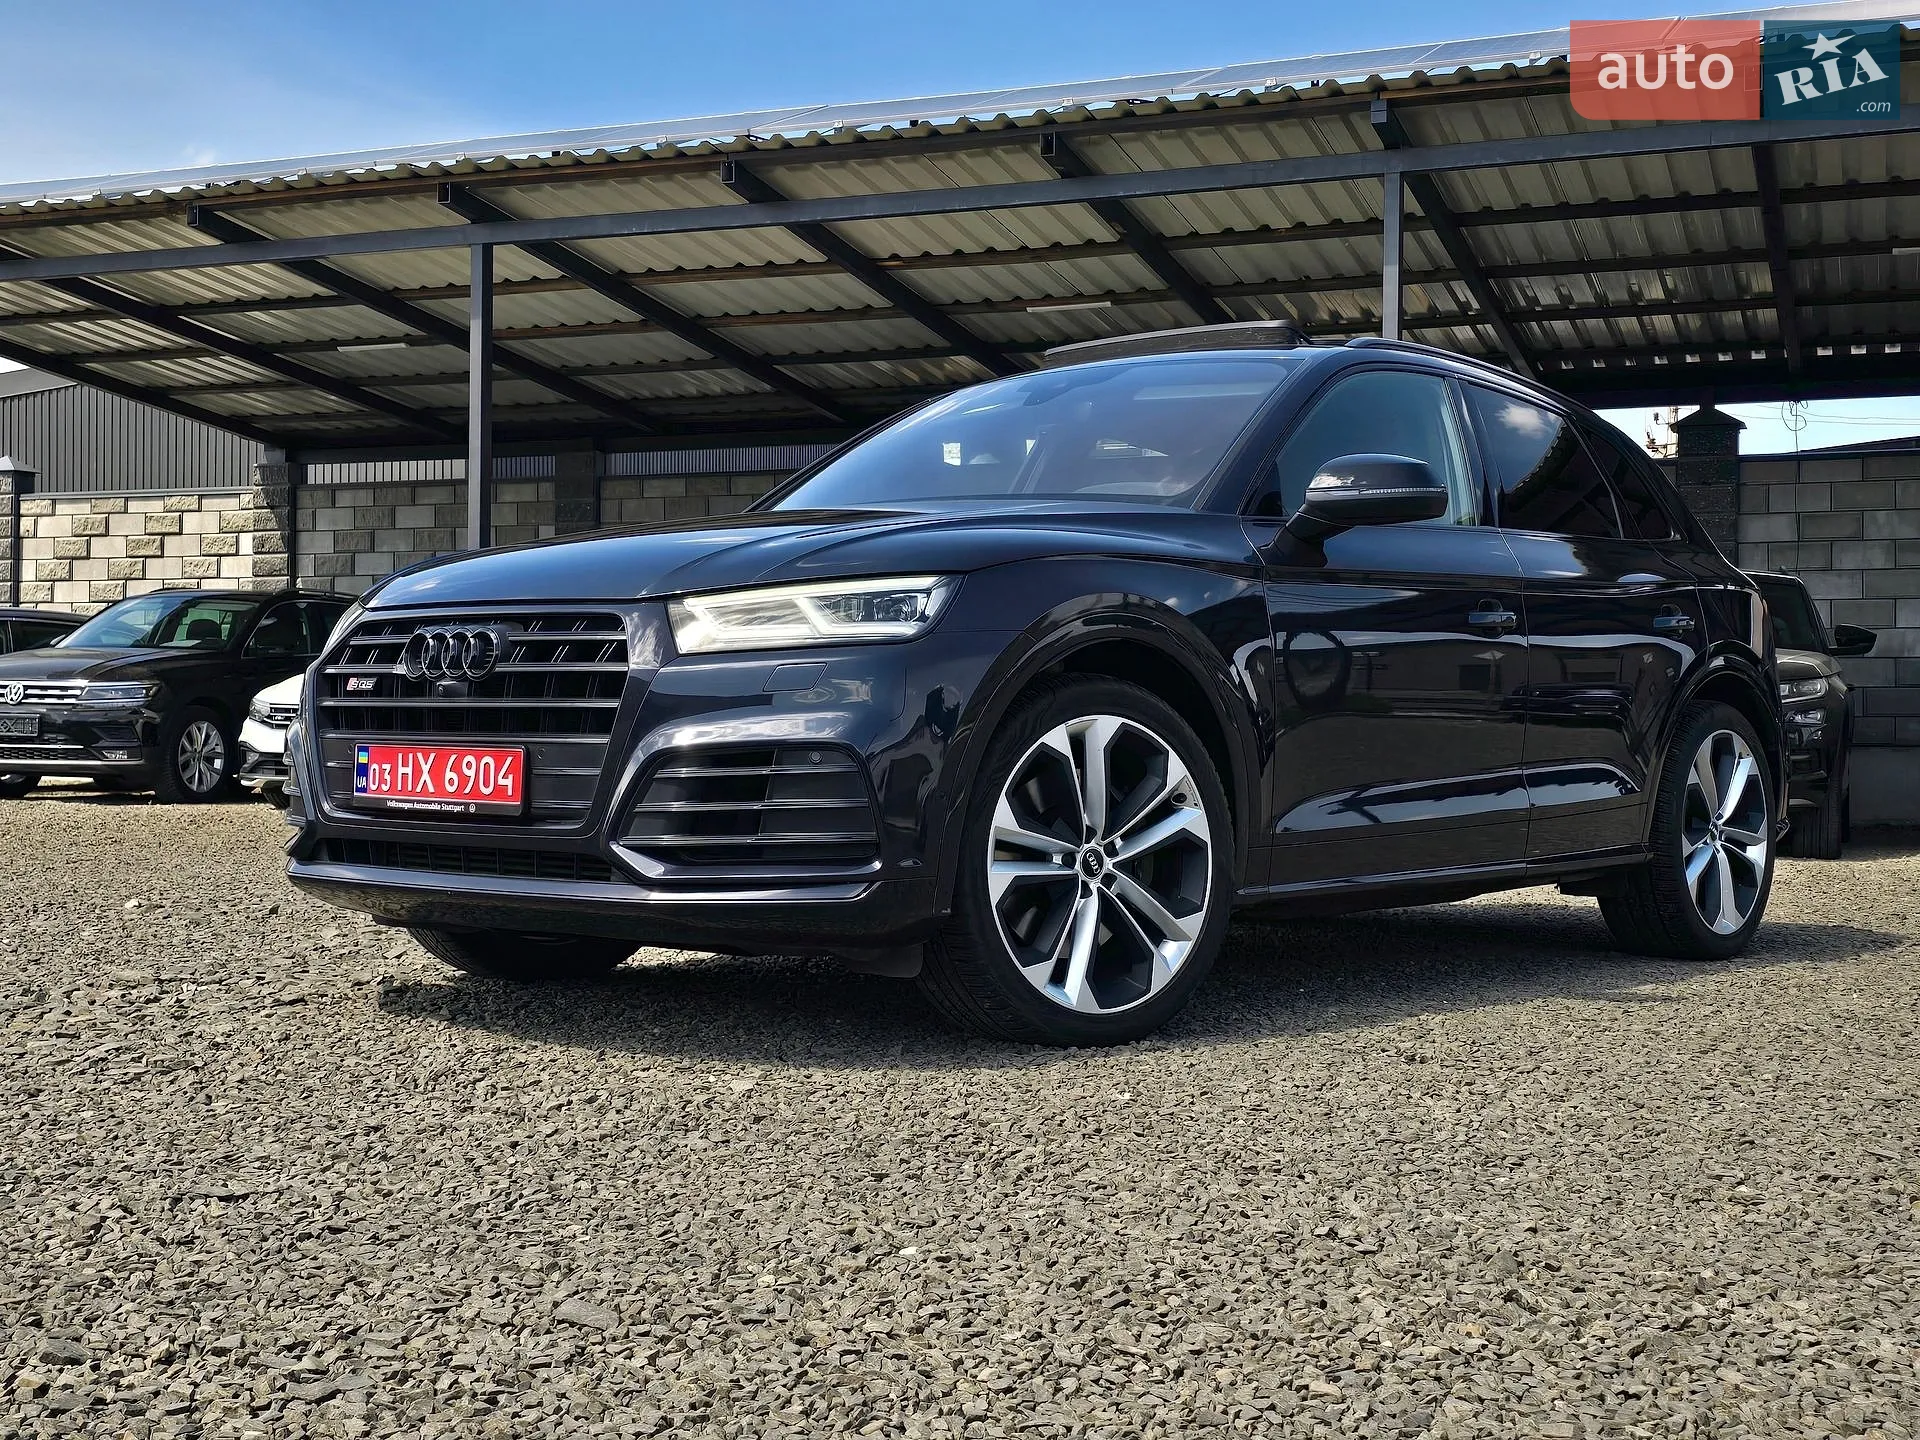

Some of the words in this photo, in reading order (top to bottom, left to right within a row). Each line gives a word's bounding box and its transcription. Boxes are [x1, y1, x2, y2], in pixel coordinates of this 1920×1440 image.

[369, 763, 392, 792] 03
[397, 752, 436, 793] HX
[444, 754, 514, 797] 6904
[357, 776, 367, 788] UA
[386, 800, 414, 810] Volkswagen
